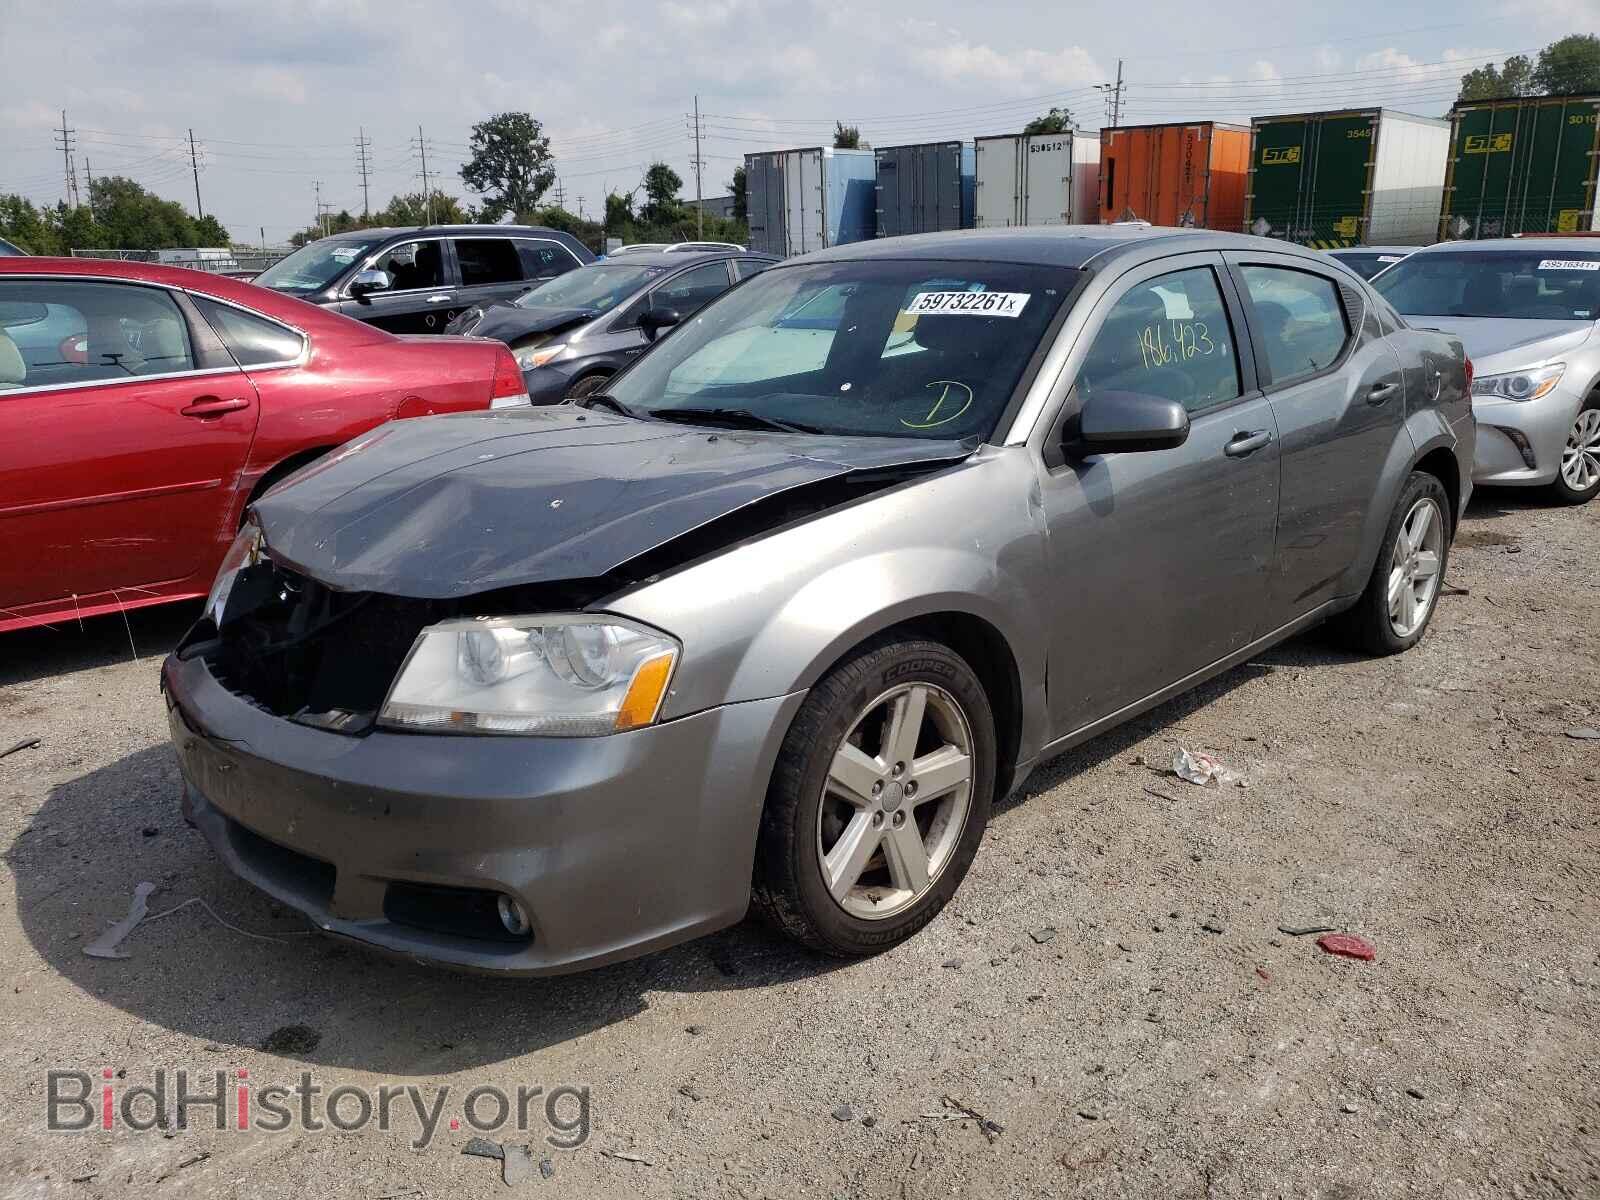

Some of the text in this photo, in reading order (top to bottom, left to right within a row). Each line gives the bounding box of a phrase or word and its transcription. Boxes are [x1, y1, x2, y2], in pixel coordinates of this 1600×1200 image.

[1137, 319, 1214, 369] 186,423
[900, 380, 973, 428] D
[884, 658, 957, 683] COOPER
